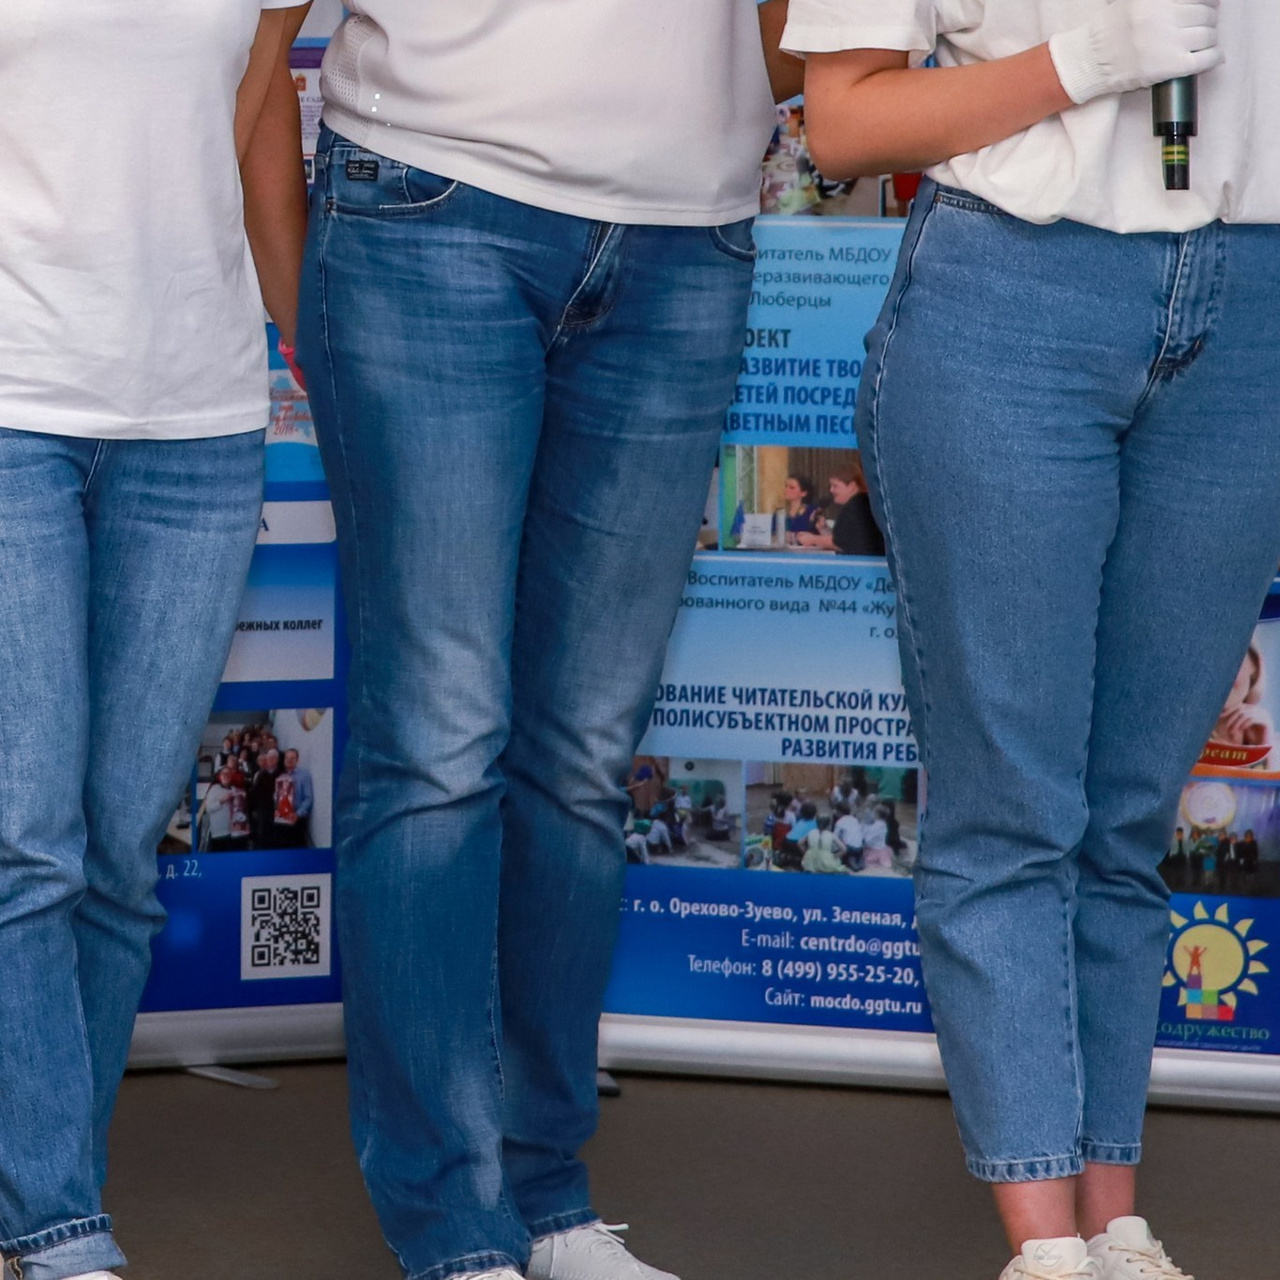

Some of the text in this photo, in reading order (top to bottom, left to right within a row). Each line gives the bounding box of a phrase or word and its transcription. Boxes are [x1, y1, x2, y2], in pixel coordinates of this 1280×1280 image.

[829, 248, 893, 264] МБДОУ
[750, 291, 831, 310] Люберцы
[730, 384, 778, 406] ЕТЕЙ
[687, 571, 794, 589] Воспитатель
[799, 575, 862, 593] МБДОУ
[770, 600, 810, 613] вида
[819, 599, 856, 613] №44
[283, 618, 323, 631] коллег
[732, 686, 873, 711] ЧИТАТЕЛЬСКОЙ
[653, 708, 829, 734] ПОЛИСУБЪЕКТНОМ
[781, 738, 920, 763] РАЗВИТИЯ РЕБ
[650, 900, 665, 914] о.
[670, 897, 797, 923] Орехово-Зуево,
[803, 908, 828, 925] ул.
[832, 906, 907, 929] Зеленая,
[741, 929, 795, 950] E-mail:
[688, 955, 919, 988] Телефон: 8 (499) 955-25-20,
[764, 987, 922, 1016] Сайт: mocdo.ggtu.ru
